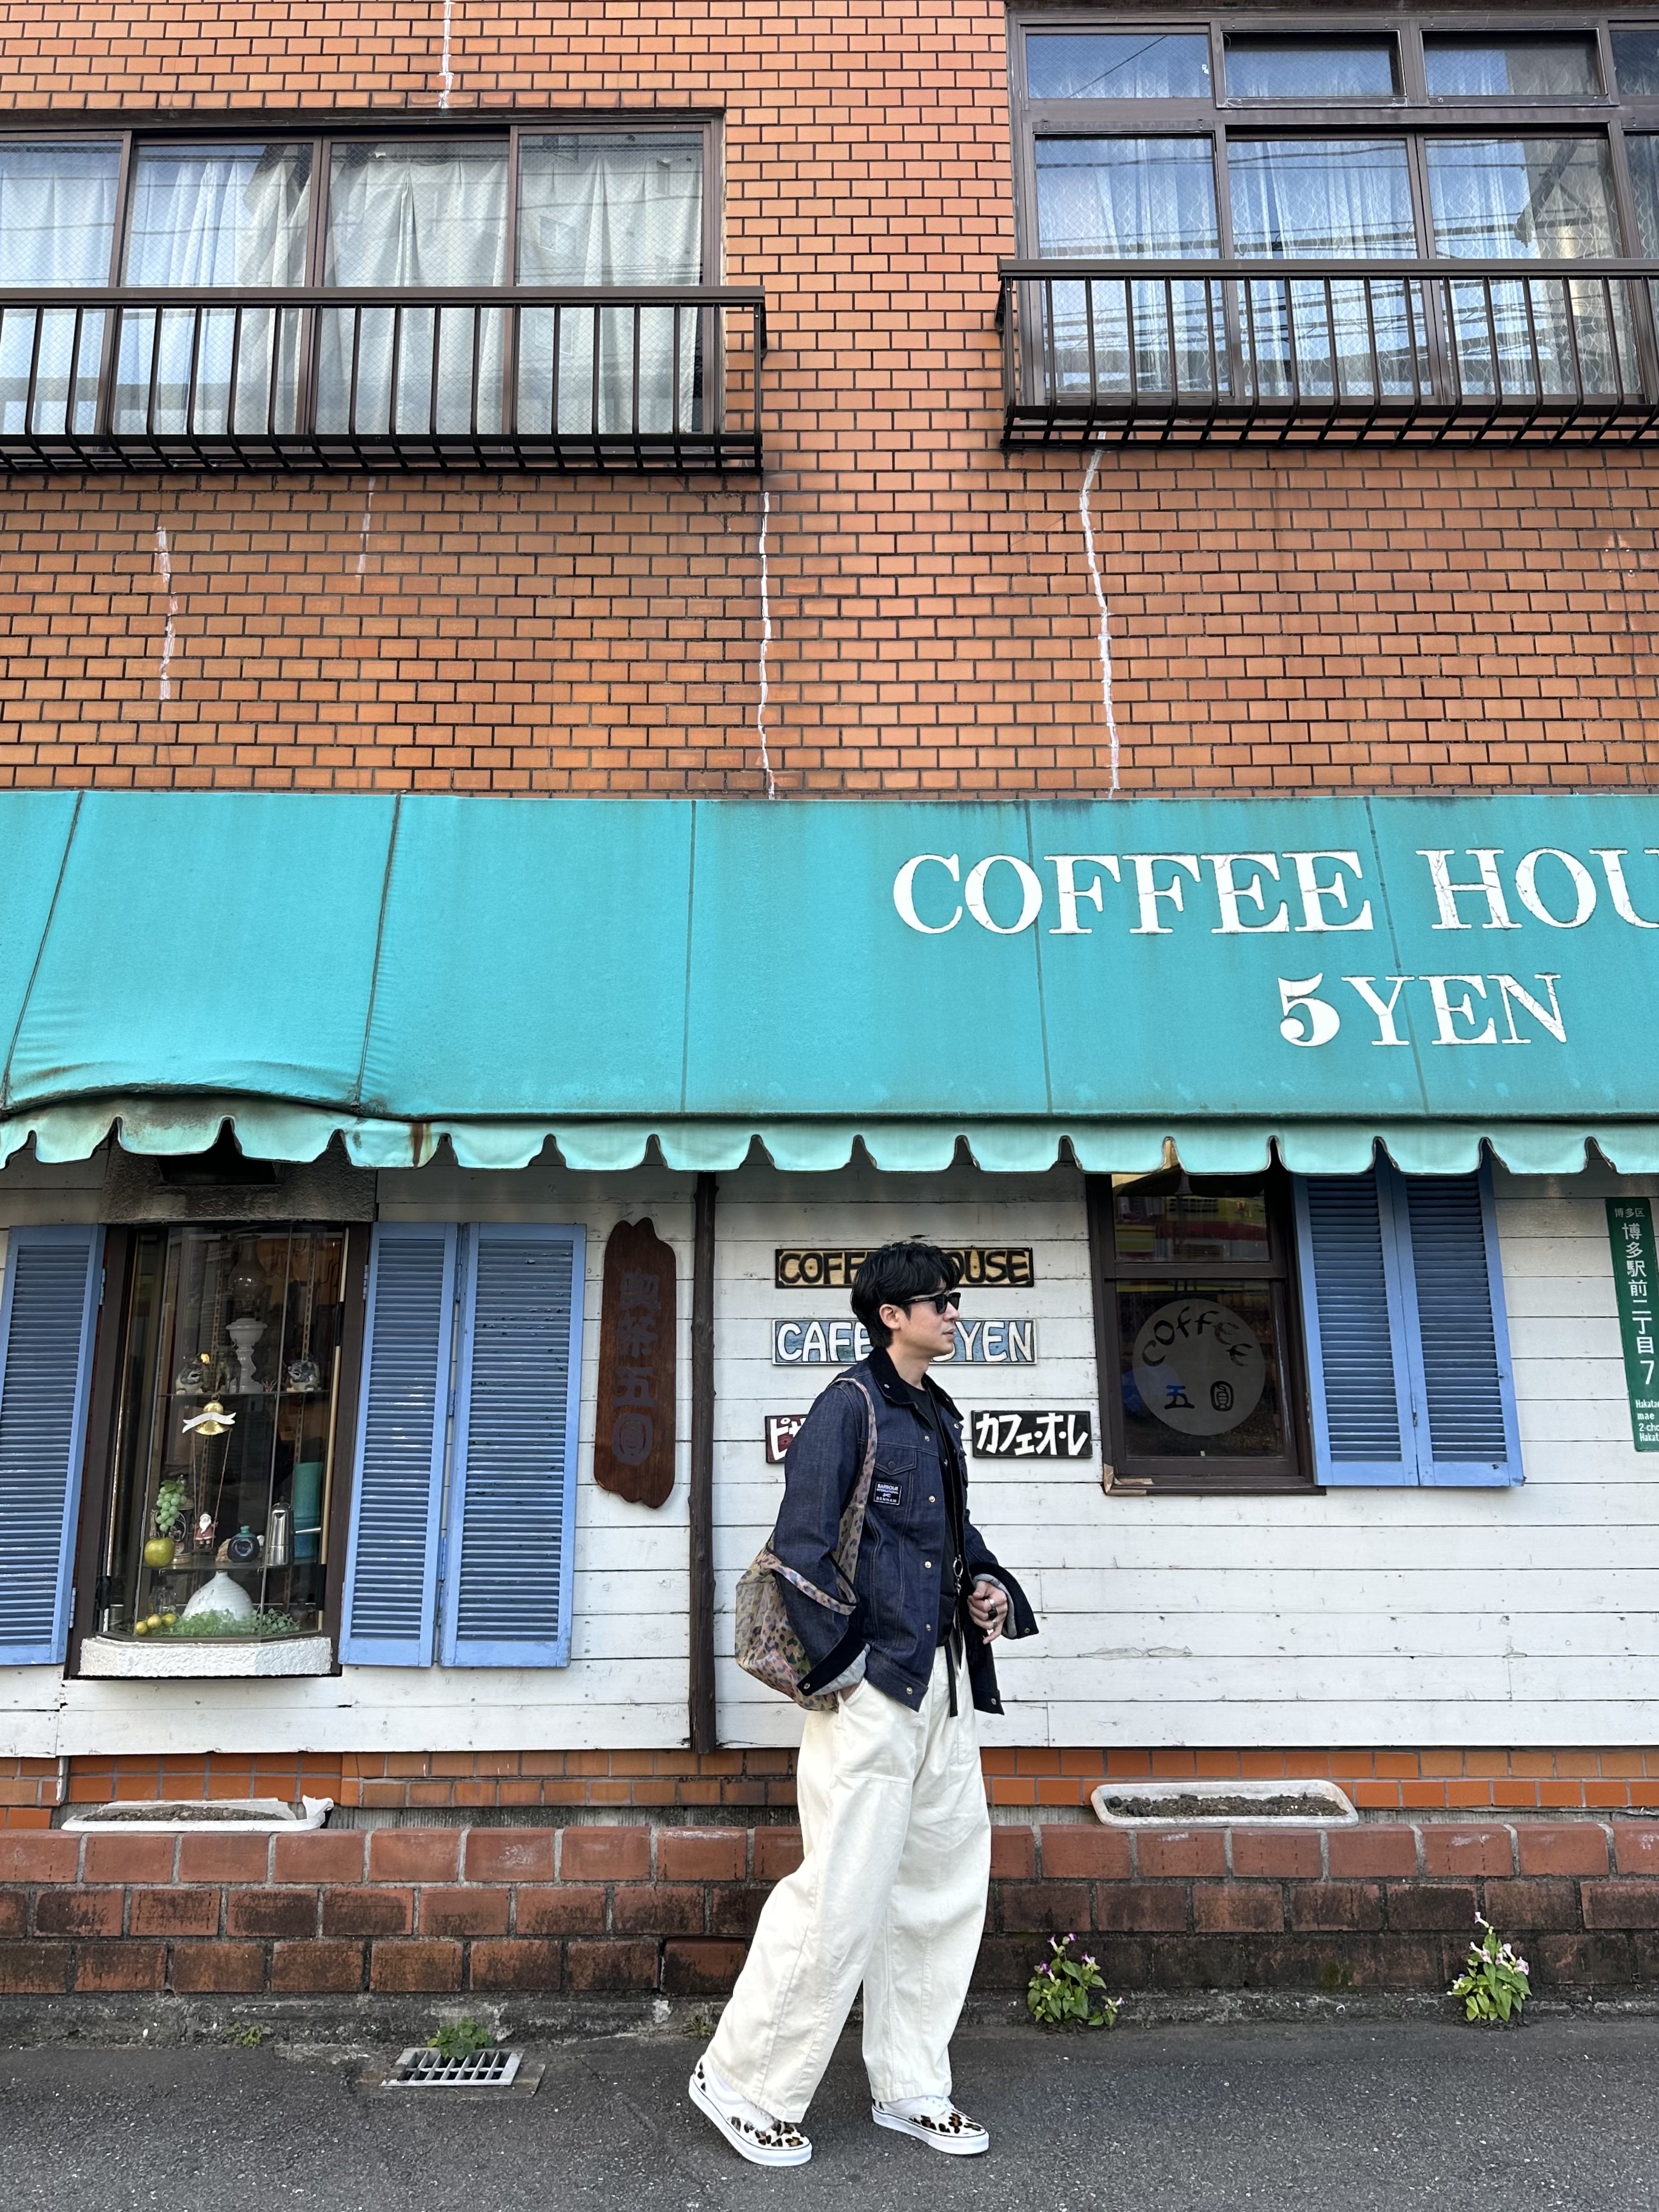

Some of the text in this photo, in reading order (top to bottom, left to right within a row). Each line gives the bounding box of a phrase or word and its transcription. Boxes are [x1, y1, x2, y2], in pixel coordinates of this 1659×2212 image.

[893, 850, 1374, 935] COFFEE
[1614, 1207, 1646, 1218] 博多区
[780, 1252, 877, 1285] COFF
[777, 1321, 873, 1362] CAFE
